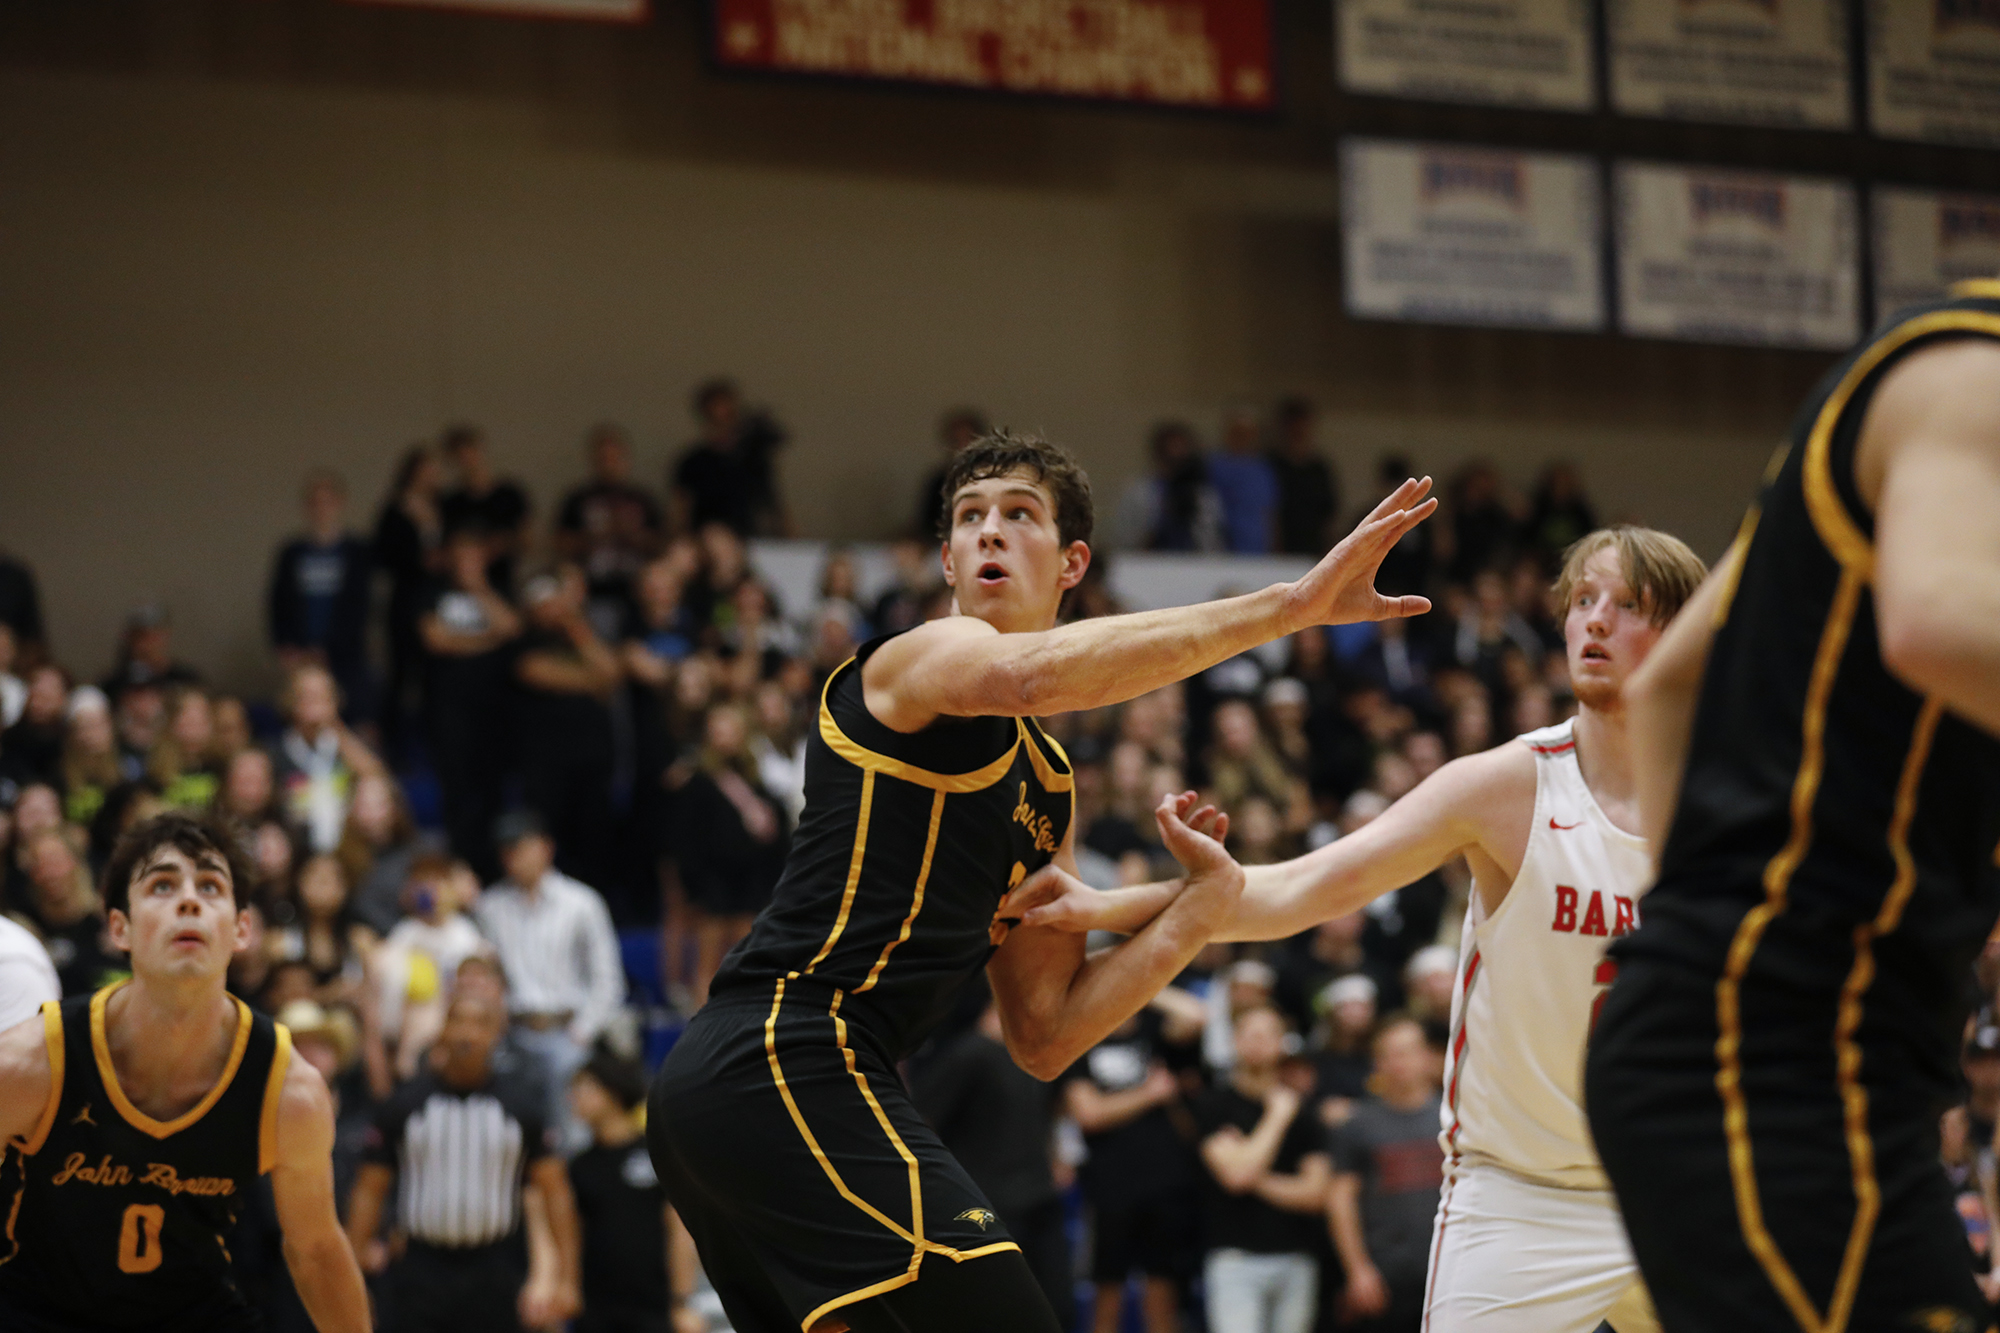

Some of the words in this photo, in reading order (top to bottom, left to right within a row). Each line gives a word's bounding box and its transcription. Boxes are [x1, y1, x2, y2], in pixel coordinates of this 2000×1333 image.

[1551, 884, 1643, 937] BAR
[52, 1152, 133, 1186] John
[139, 1162, 237, 1196] Brown
[117, 1203, 165, 1274] 0
